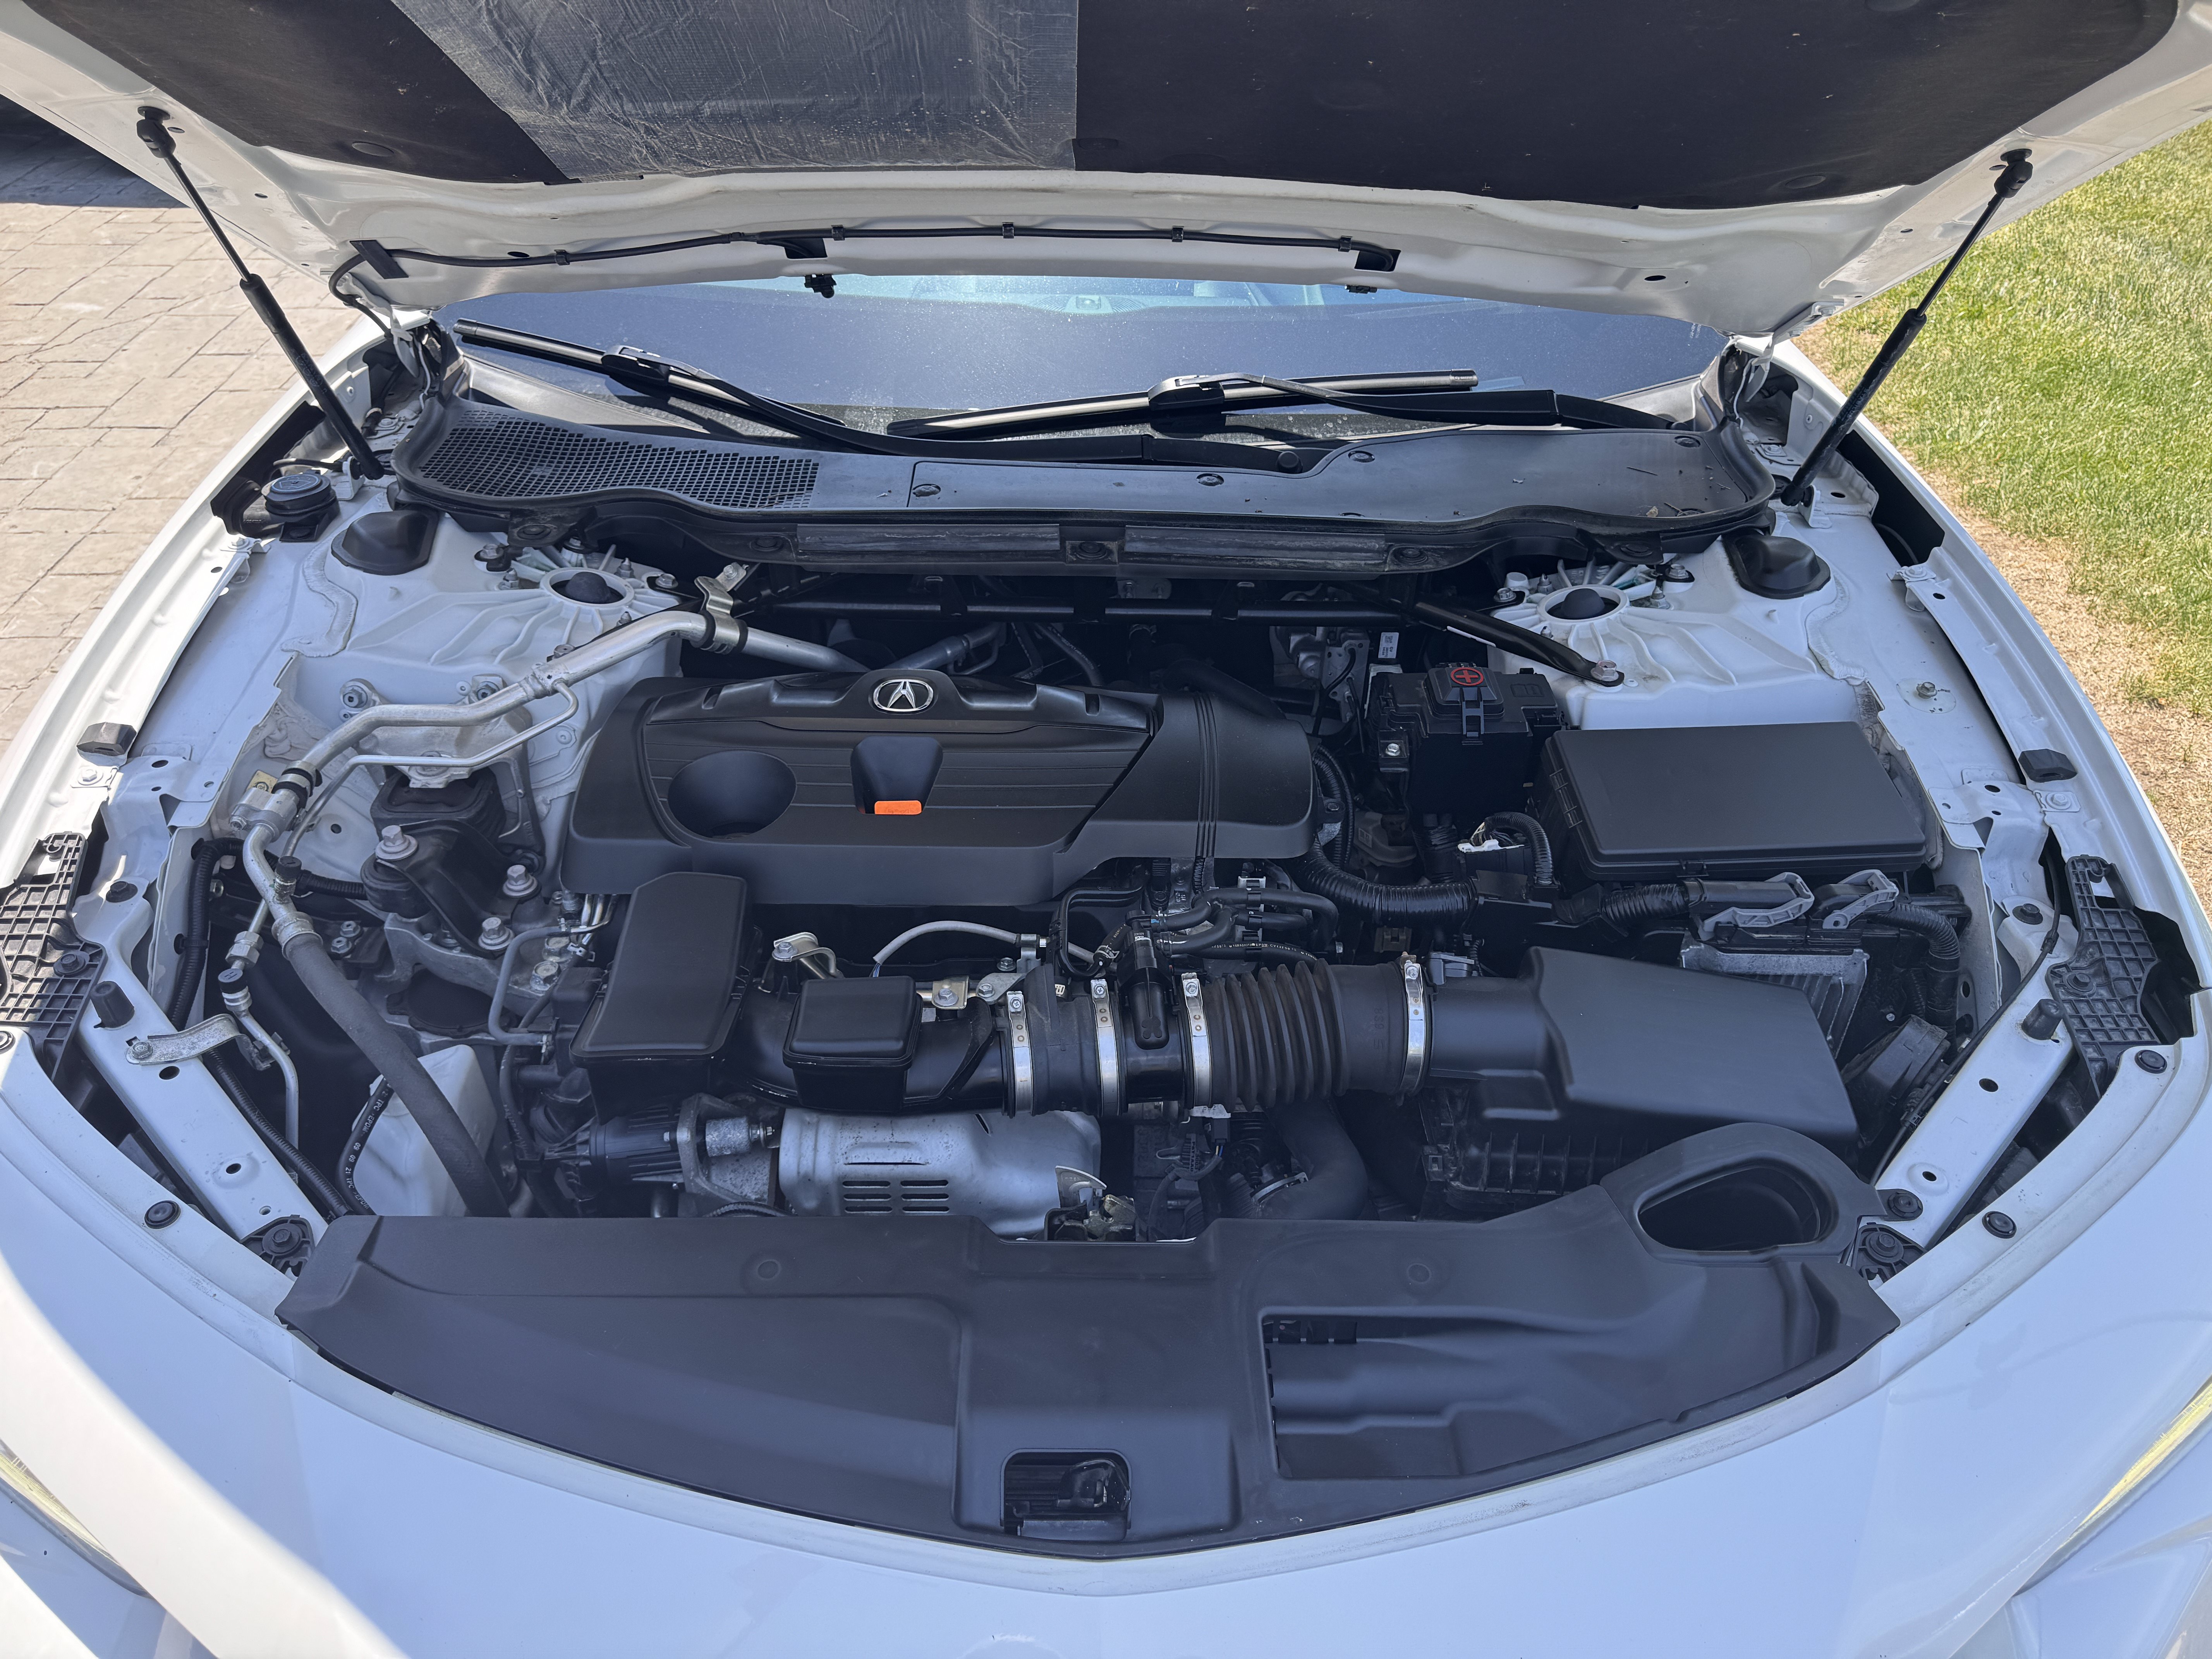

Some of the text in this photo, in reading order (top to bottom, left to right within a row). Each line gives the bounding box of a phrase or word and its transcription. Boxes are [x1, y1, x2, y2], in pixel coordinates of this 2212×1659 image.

[224, 971, 237, 979] H
[373, 1099, 385, 1111] TPC
[353, 1142, 361, 1151] 09
[349, 1154, 356, 1163] 09
[346, 1178, 355, 1189] TPC
